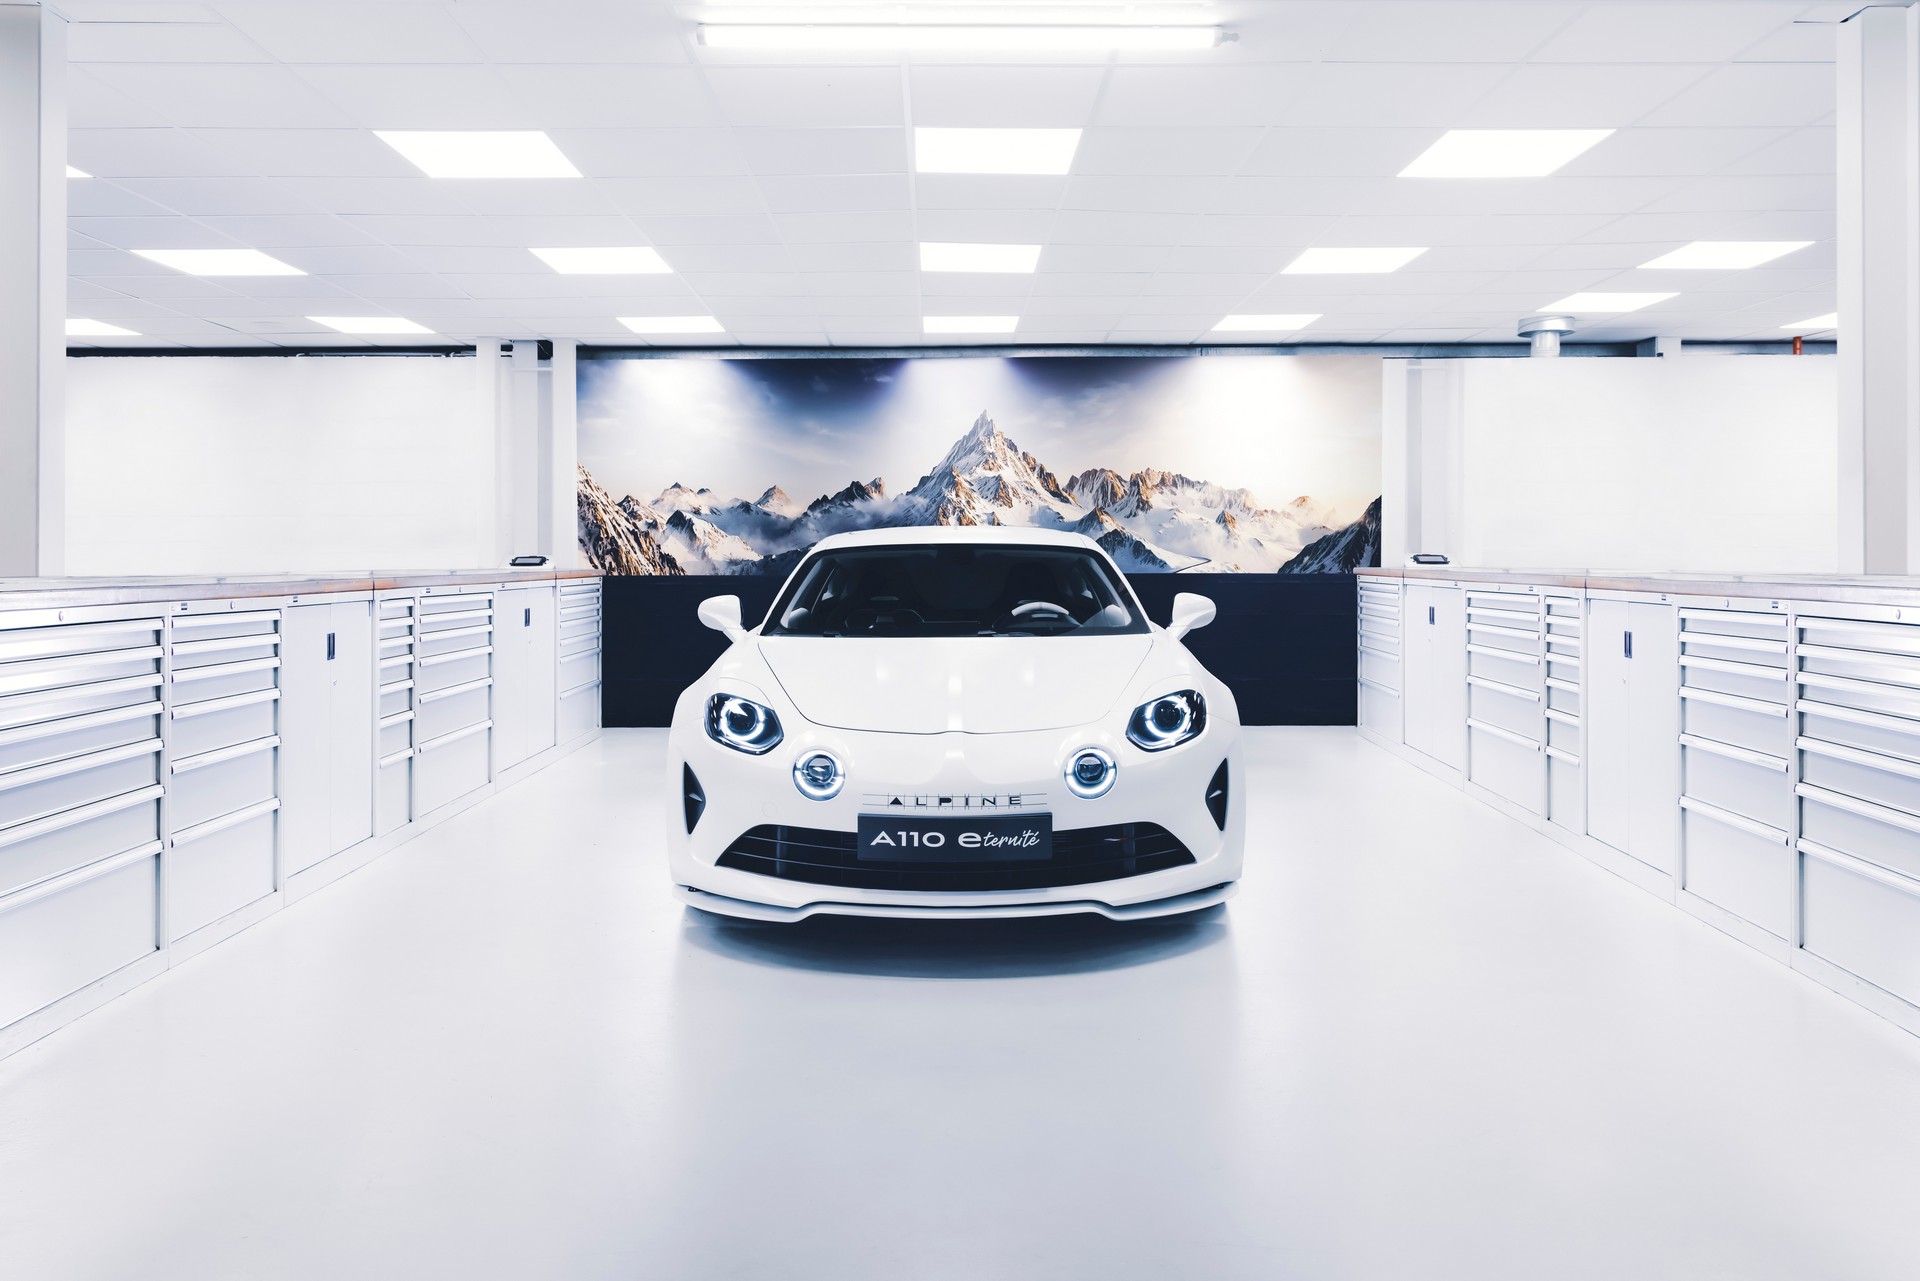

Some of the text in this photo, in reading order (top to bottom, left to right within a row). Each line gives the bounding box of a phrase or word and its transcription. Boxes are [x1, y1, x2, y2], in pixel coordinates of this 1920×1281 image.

[889, 796, 1021, 806] ALPINE
[870, 829, 1040, 848] A110 eternité
